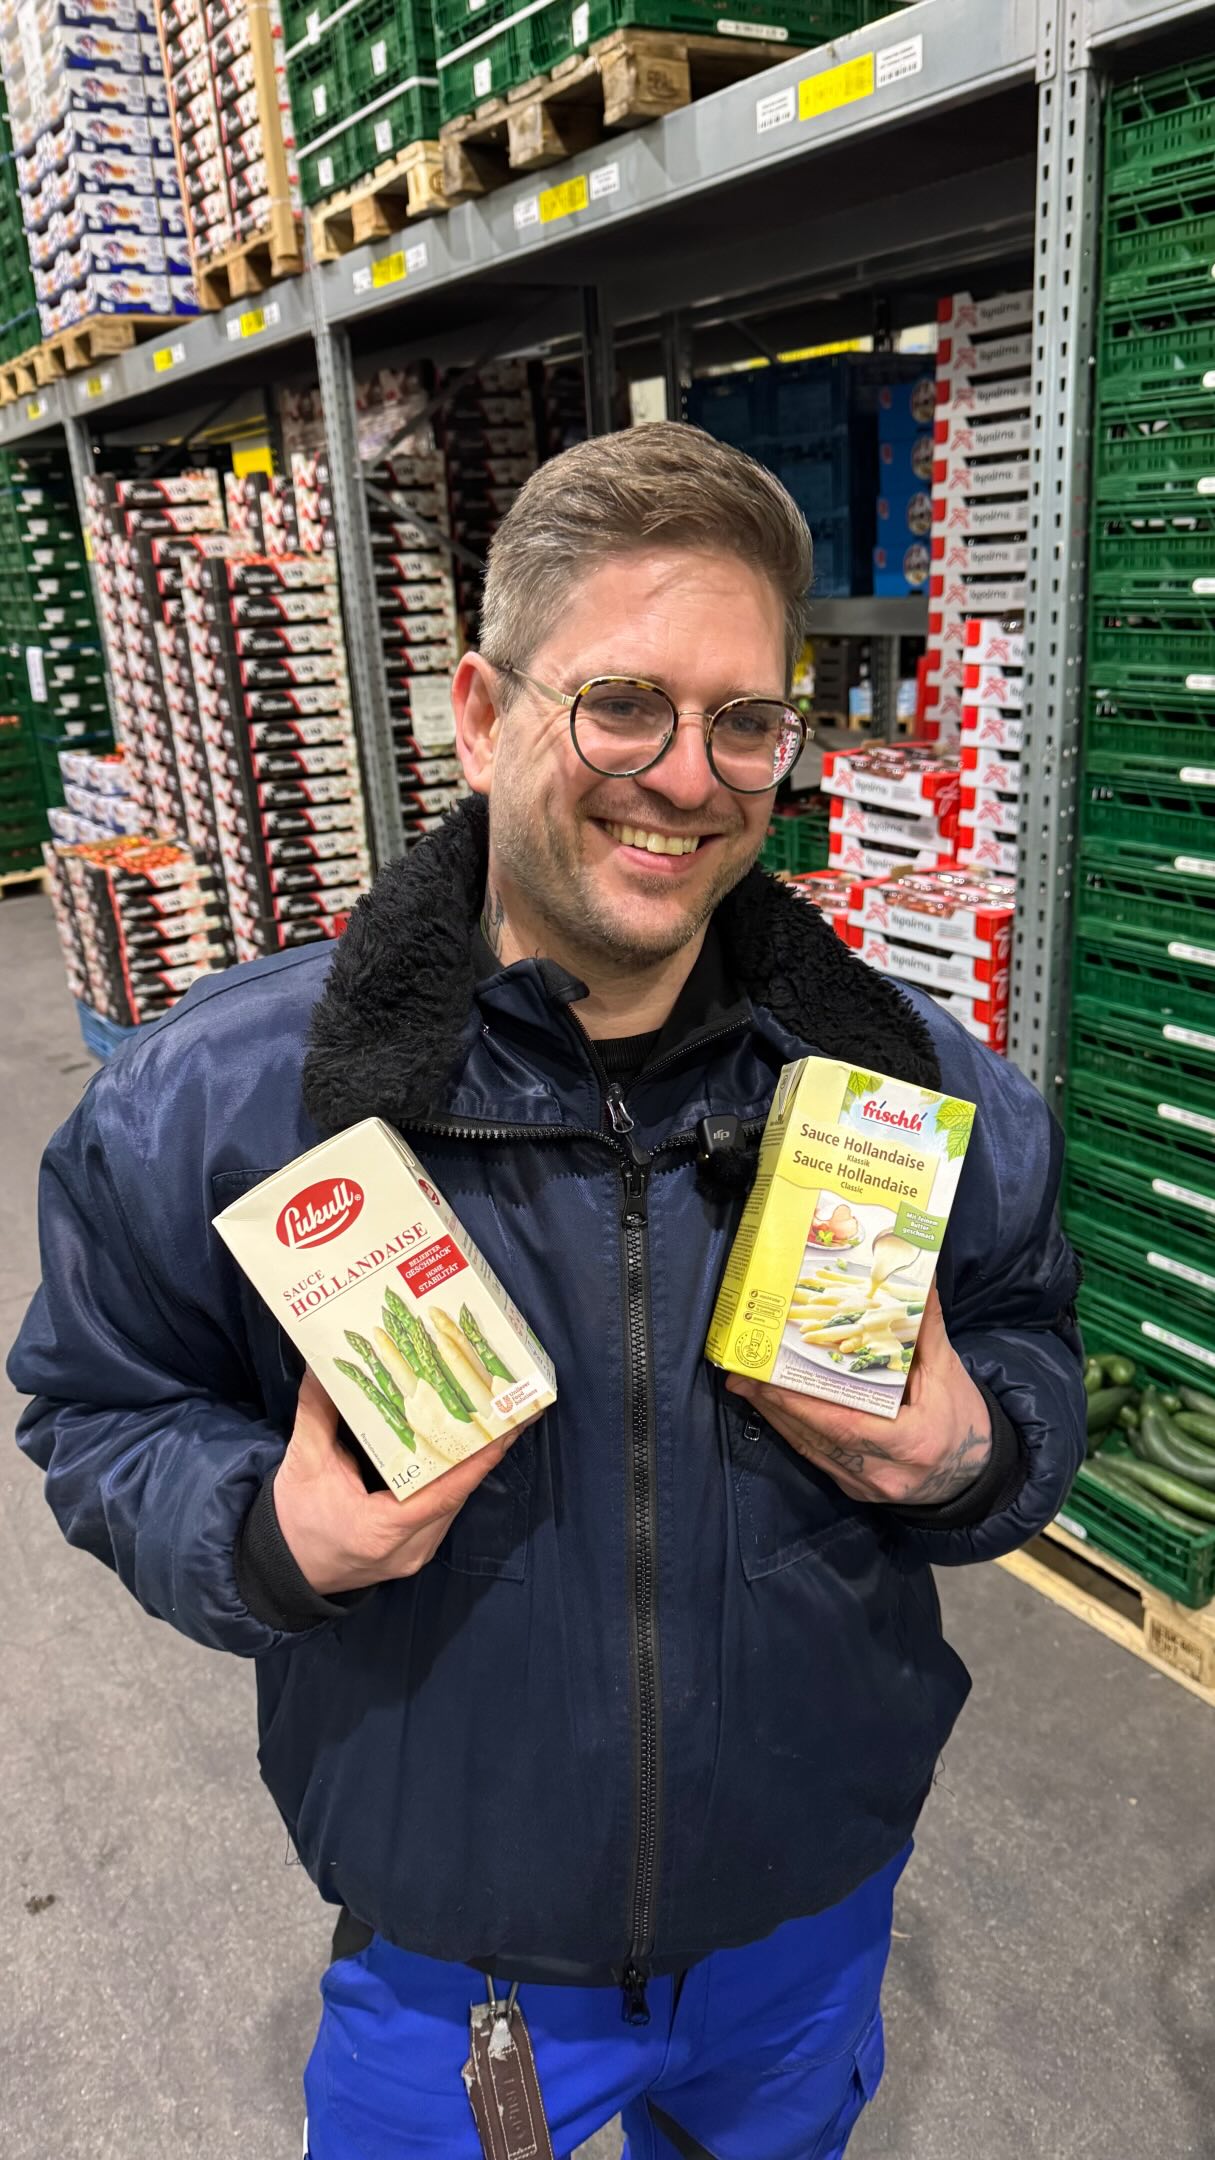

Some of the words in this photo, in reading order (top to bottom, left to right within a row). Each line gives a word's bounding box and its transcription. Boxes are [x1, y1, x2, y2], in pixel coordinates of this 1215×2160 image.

[862, 1100, 928, 1132] frischli
[800, 1123, 840, 1147] Sauce
[843, 1136, 925, 1172] Hollandaise
[847, 1154, 871, 1168] Klassik
[793, 1150, 833, 1174] Sauce
[836, 1163, 918, 1199] Hollandaise
[840, 1181, 863, 1194] Classic
[284, 1180, 354, 1249] Lukull
[903, 1228, 935, 1240] geschmack
[409, 1243, 441, 1267] BELIEBTER
[289, 1222, 428, 1318] HOLLANDAISE
[418, 1262, 460, 1293] STABILITÄT
[426, 1264, 444, 1278] HOHE
[283, 1269, 325, 1301] SAUCE
[508, 1380, 530, 1398] Unilever
[510, 1390, 525, 1404] Food
[514, 1389, 538, 1407] Solutions
